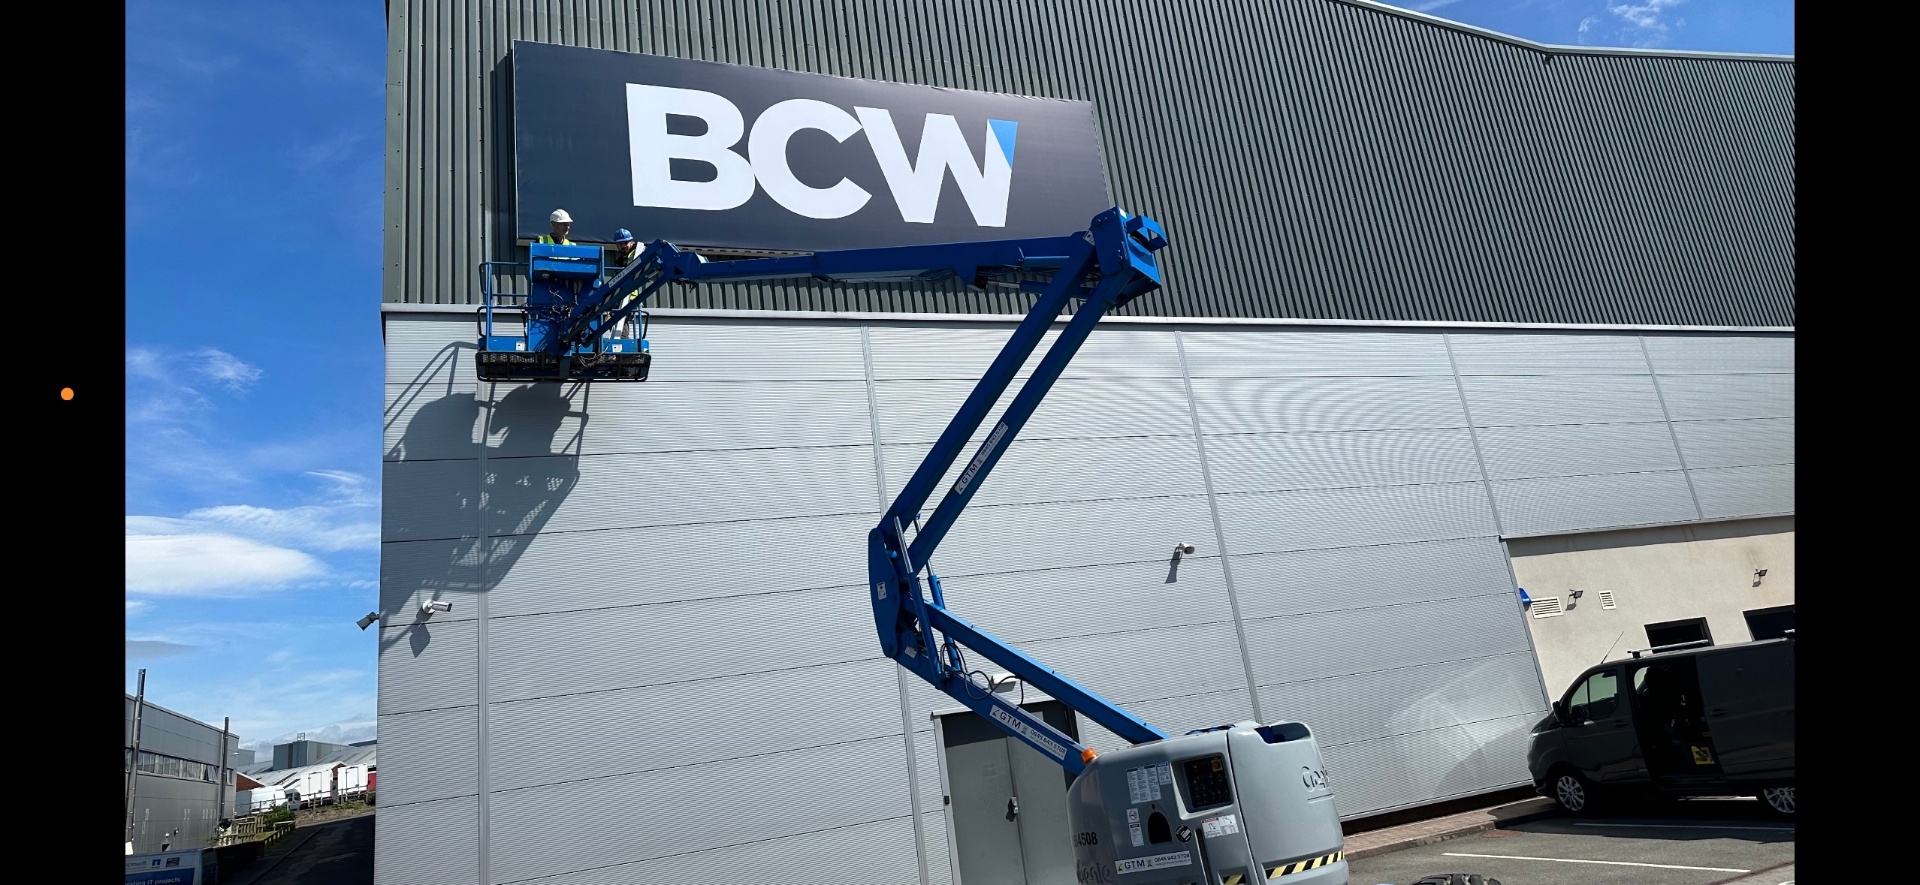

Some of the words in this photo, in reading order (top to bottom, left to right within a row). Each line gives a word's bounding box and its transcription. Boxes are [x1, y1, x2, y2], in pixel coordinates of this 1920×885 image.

[625, 82, 1018, 228] BCW
[962, 463, 978, 484] GTM
[1000, 711, 1021, 729] GTM
[1124, 859, 1146, 870] GTM
